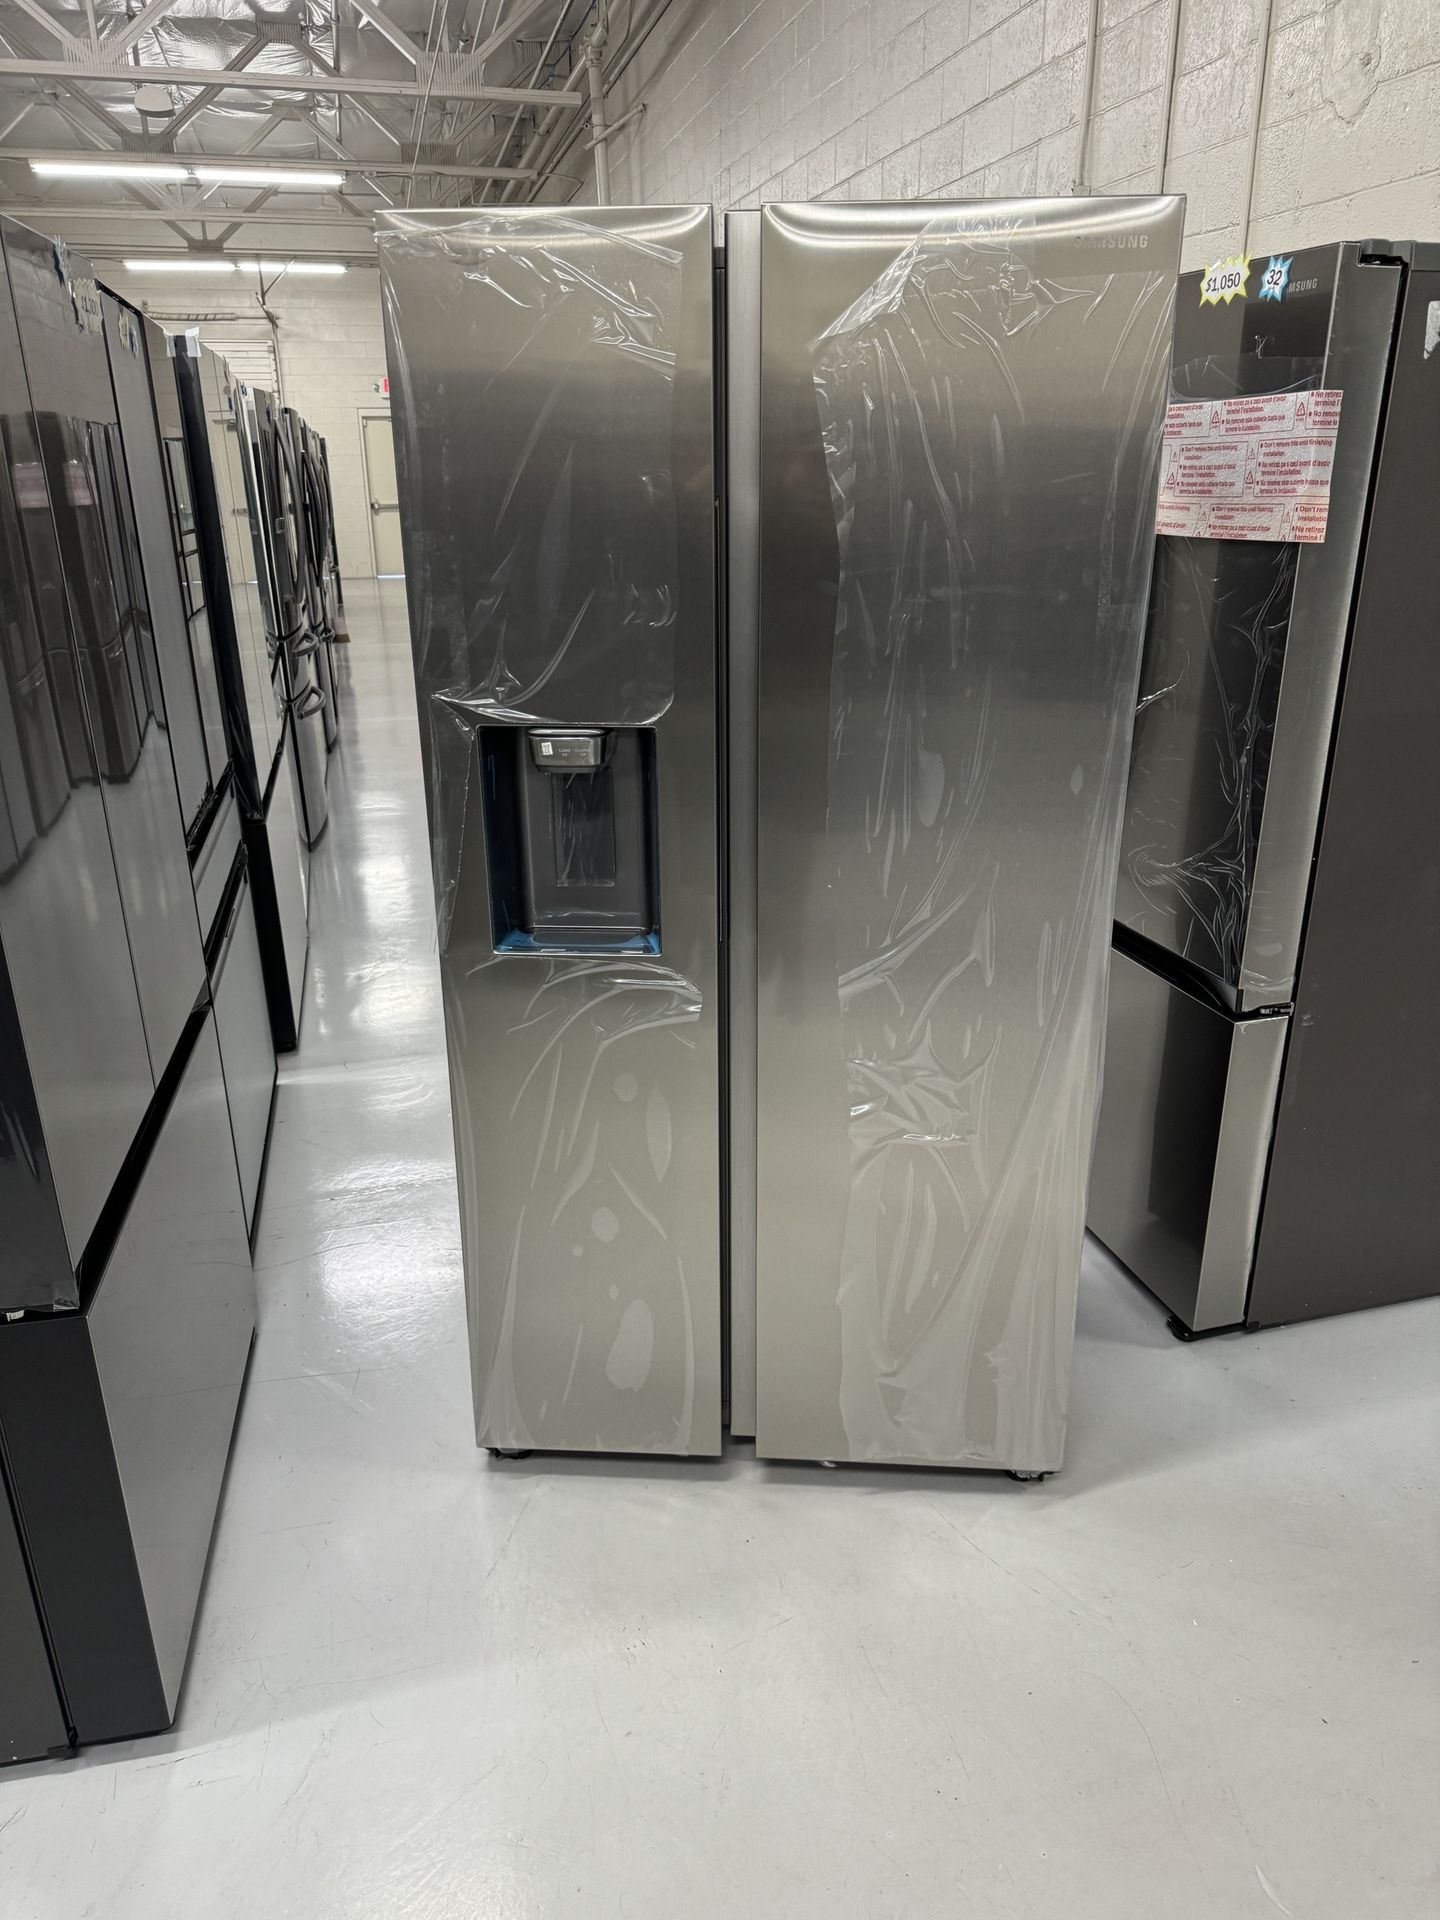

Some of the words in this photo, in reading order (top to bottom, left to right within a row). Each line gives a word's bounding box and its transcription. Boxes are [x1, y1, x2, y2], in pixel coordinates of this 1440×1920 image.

[1205, 272, 1241, 293] $1,050
[1266, 269, 1283, 286] 32
[1288, 278, 1318, 293] MSUNG
